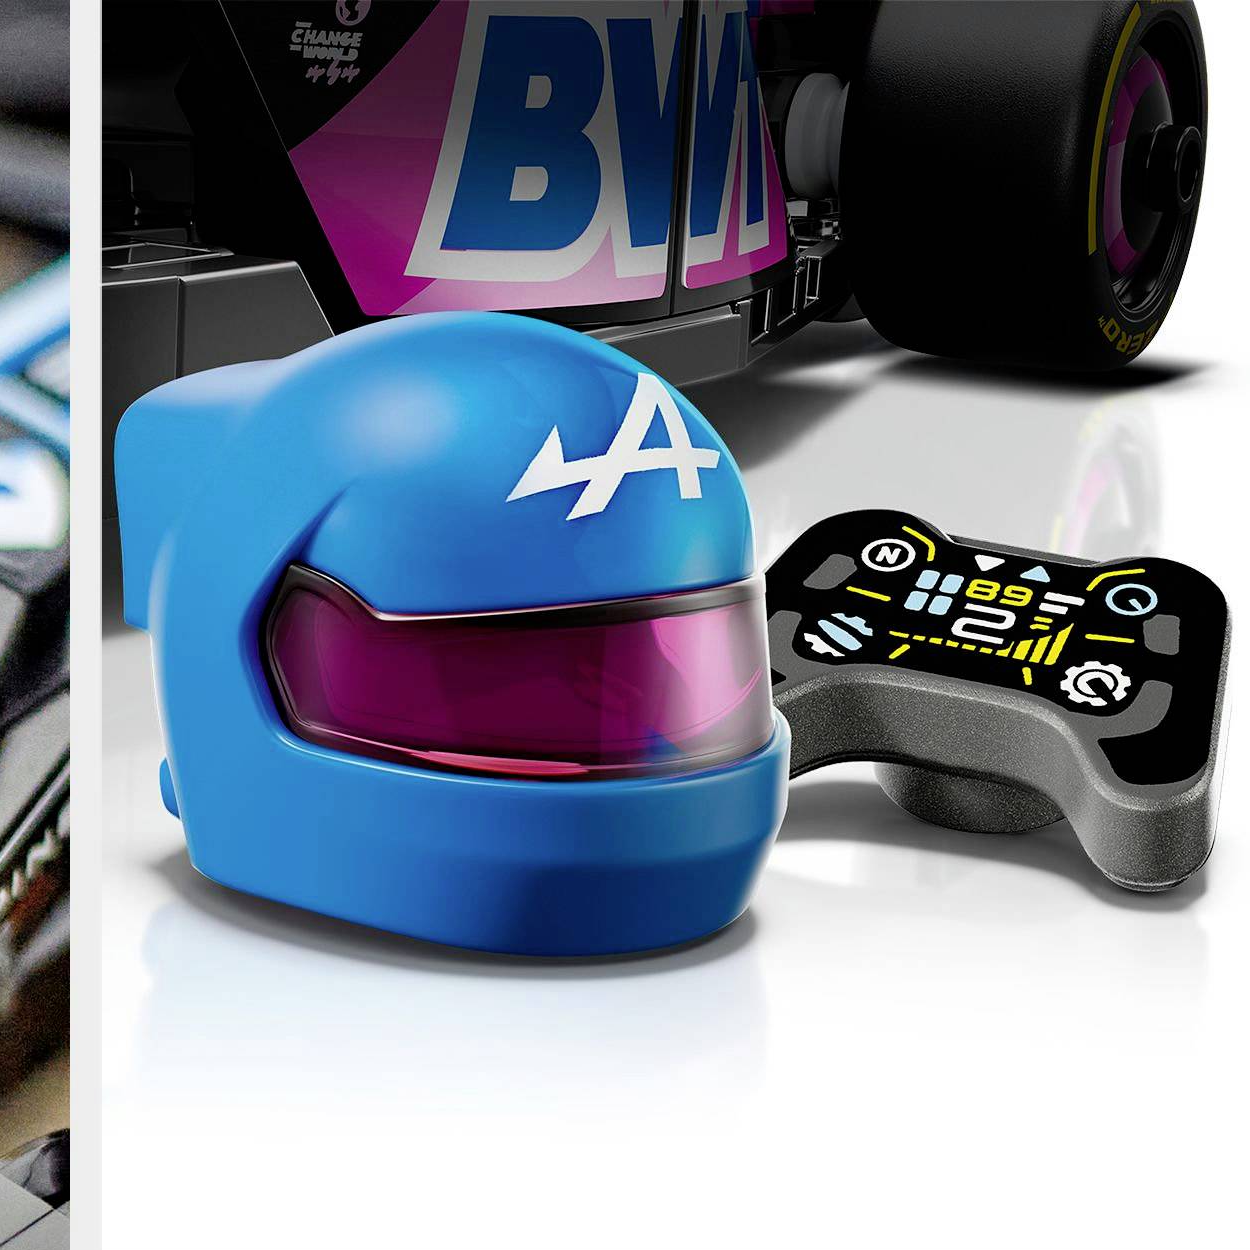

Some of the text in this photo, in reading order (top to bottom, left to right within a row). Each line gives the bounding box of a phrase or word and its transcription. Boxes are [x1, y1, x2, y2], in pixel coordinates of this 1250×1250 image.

[291, 29, 363, 47] CHANGE
[965, 579, 1033, 606] 89
[951, 604, 1016, 644] 2
